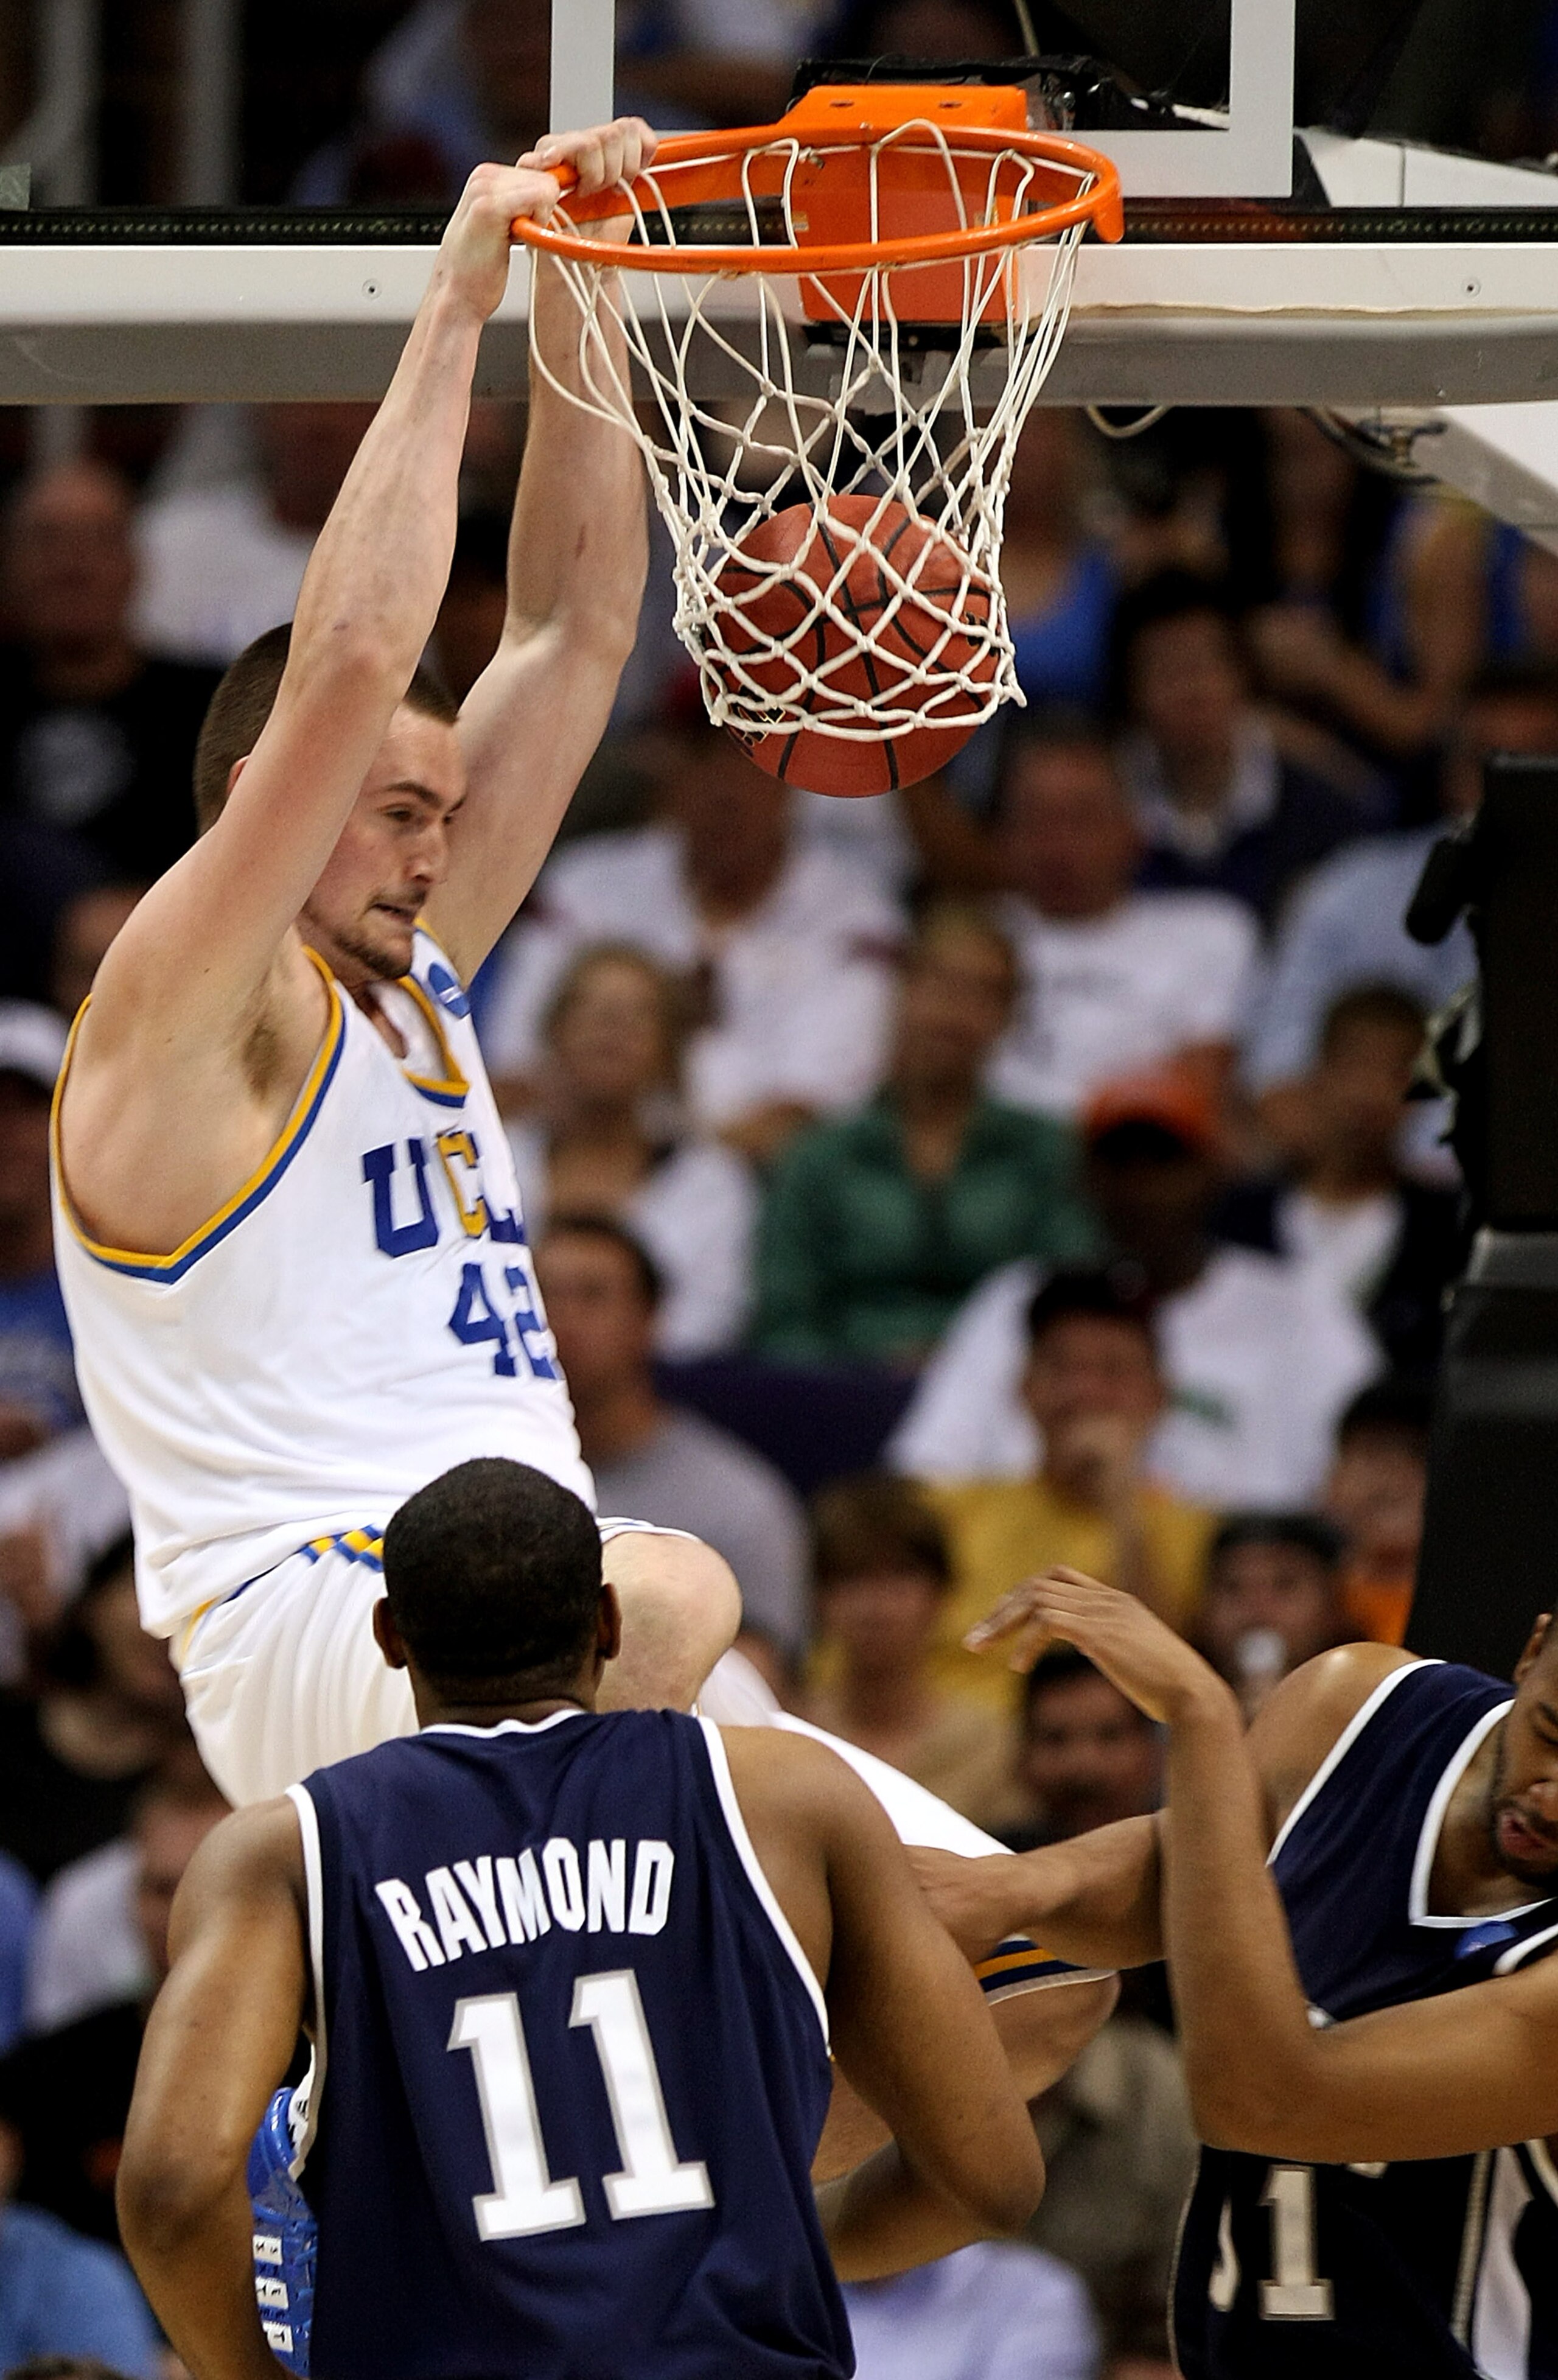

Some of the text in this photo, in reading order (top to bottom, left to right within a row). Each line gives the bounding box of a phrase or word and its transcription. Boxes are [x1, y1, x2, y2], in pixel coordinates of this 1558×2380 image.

[449, 1262, 557, 1381] 42
[375, 1838, 674, 1972] RAYMOND
[446, 1969, 716, 2242] 11
